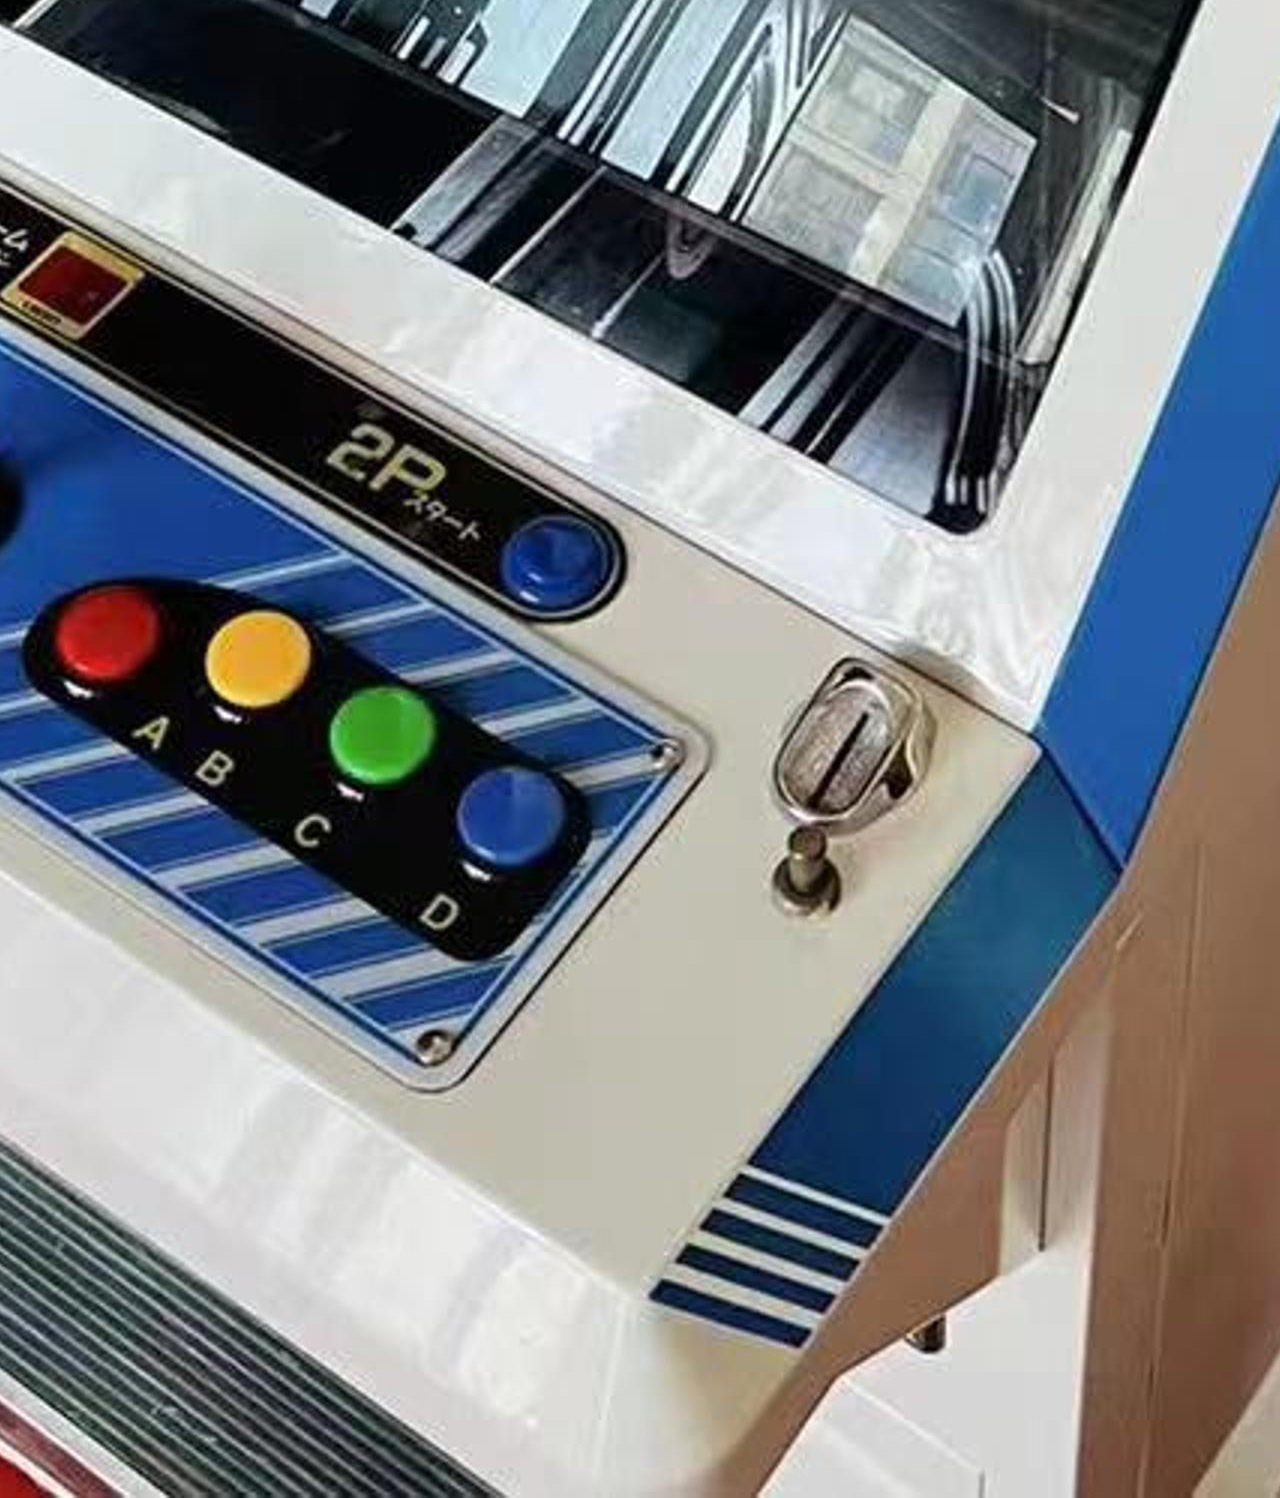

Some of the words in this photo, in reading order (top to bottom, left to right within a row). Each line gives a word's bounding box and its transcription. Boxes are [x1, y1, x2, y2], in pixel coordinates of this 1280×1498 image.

[325, 423, 447, 492] 2P
[402, 491, 484, 542] スタート
[132, 714, 171, 750] A
[194, 749, 236, 788] B
[293, 813, 332, 849] C
[419, 893, 462, 931] D
